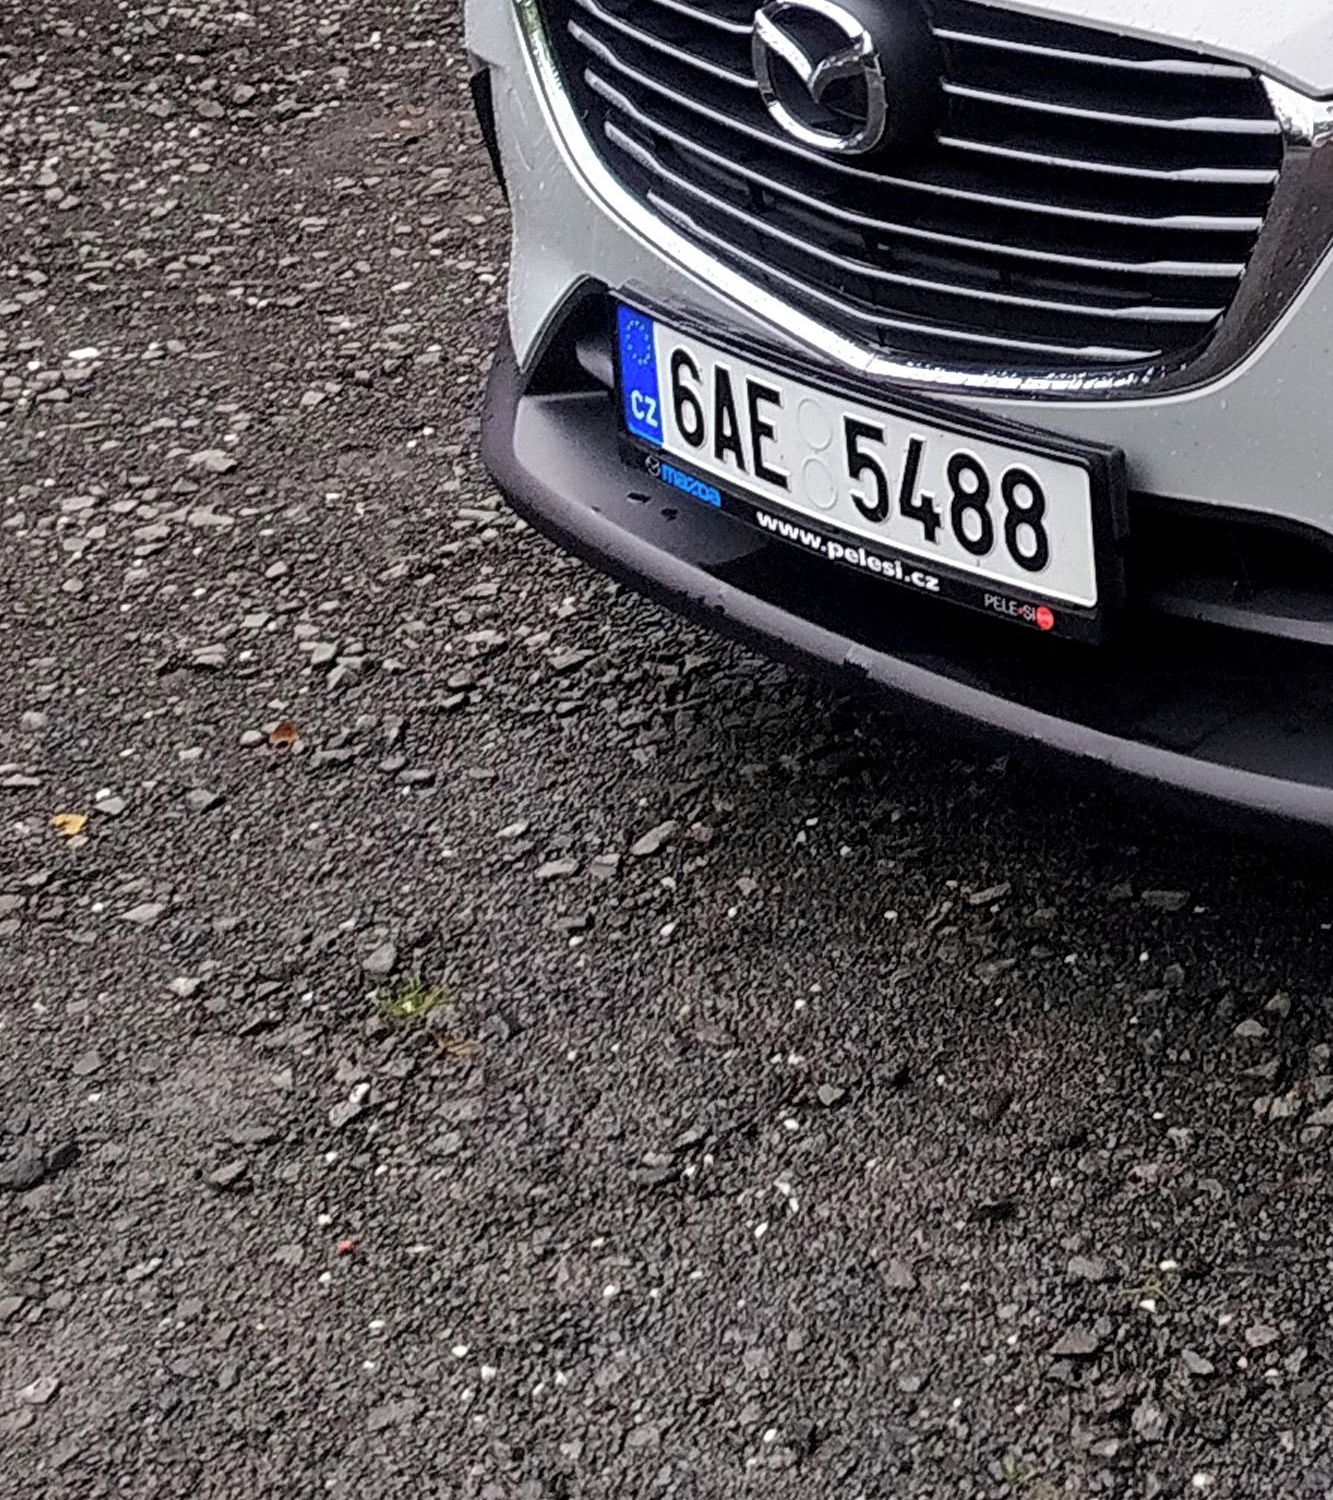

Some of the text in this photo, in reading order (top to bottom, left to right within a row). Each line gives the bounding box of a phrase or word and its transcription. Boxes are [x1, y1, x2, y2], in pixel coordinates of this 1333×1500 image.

[631, 389, 658, 428] CZ
[670, 348, 1049, 573] 6AE 5488
[756, 511, 940, 592] www.pelesi.cz
